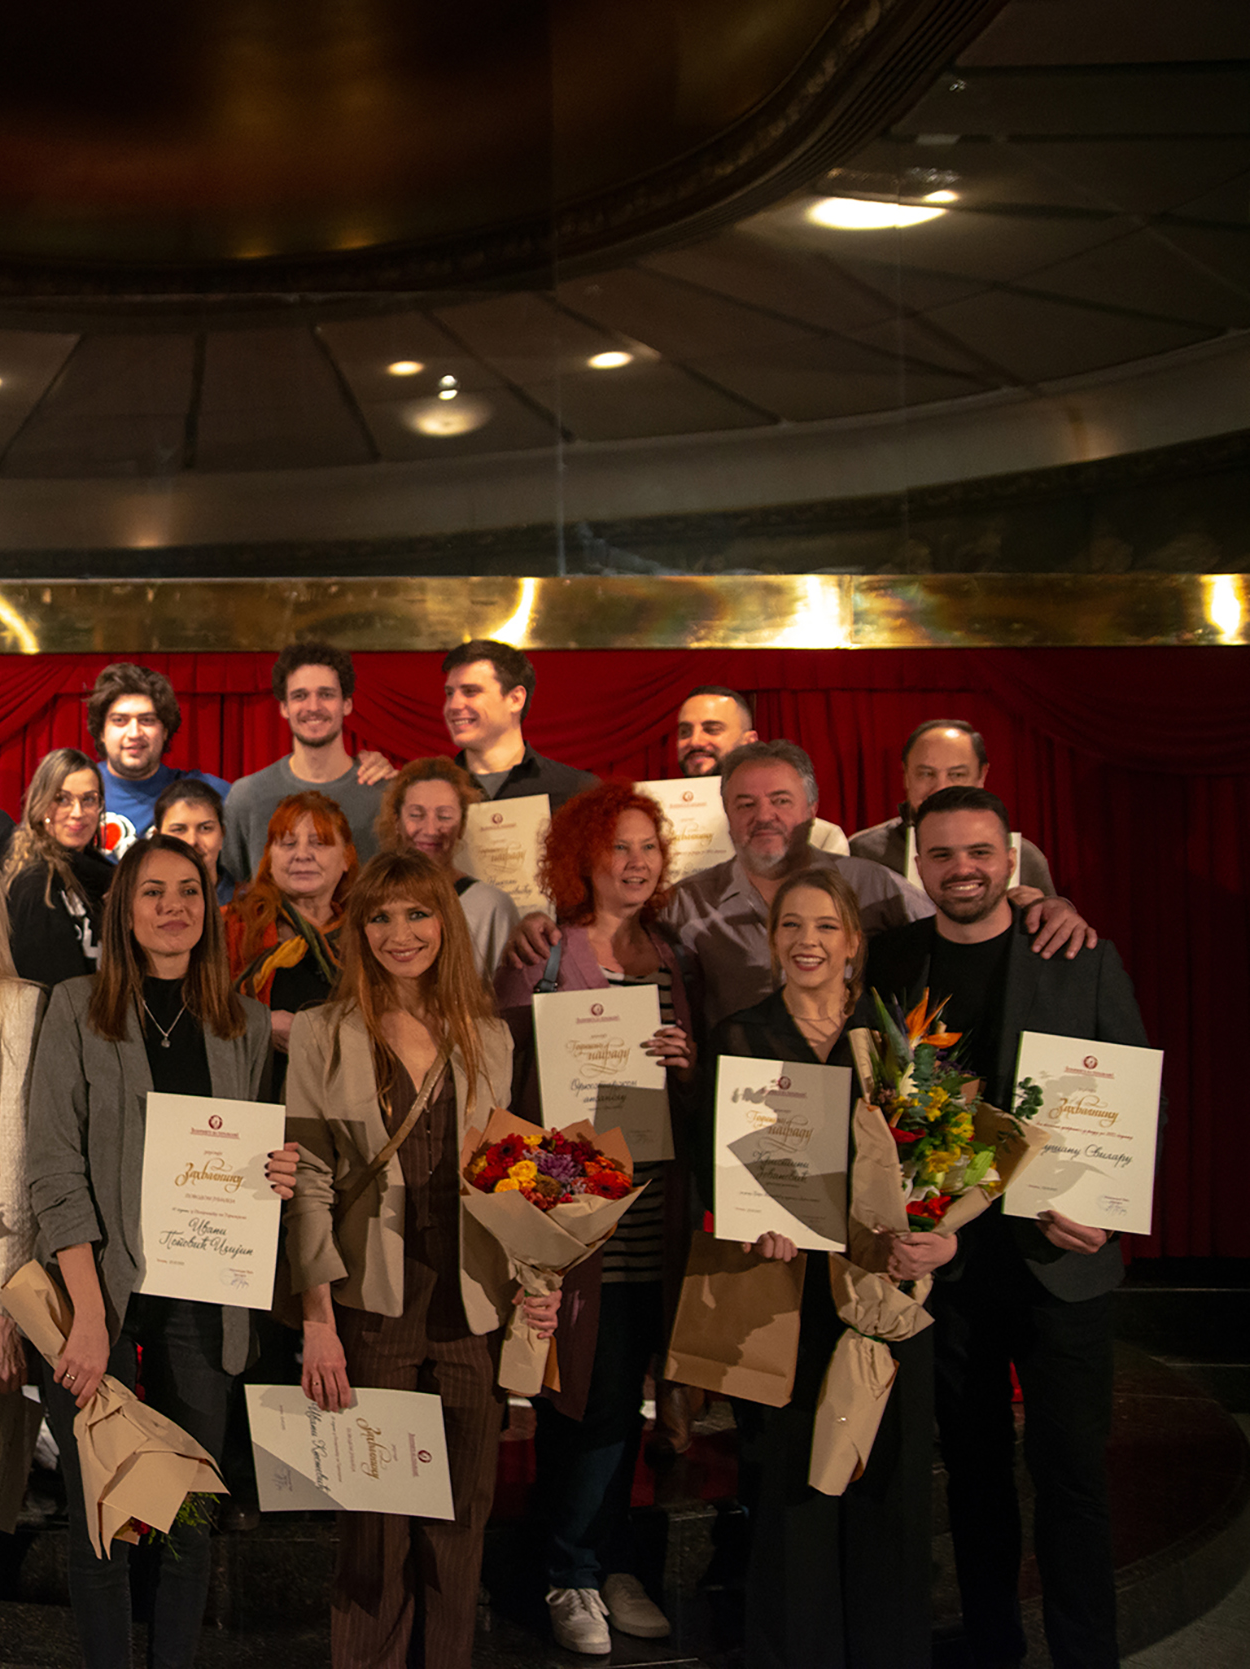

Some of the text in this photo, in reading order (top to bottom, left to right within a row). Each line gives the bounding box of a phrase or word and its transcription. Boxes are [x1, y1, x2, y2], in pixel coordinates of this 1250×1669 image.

[1043, 1143, 1133, 1167] ушану Свилару
[175, 1157, 244, 1193] Захвалницу
[188, 1217, 227, 1236] Ивани
